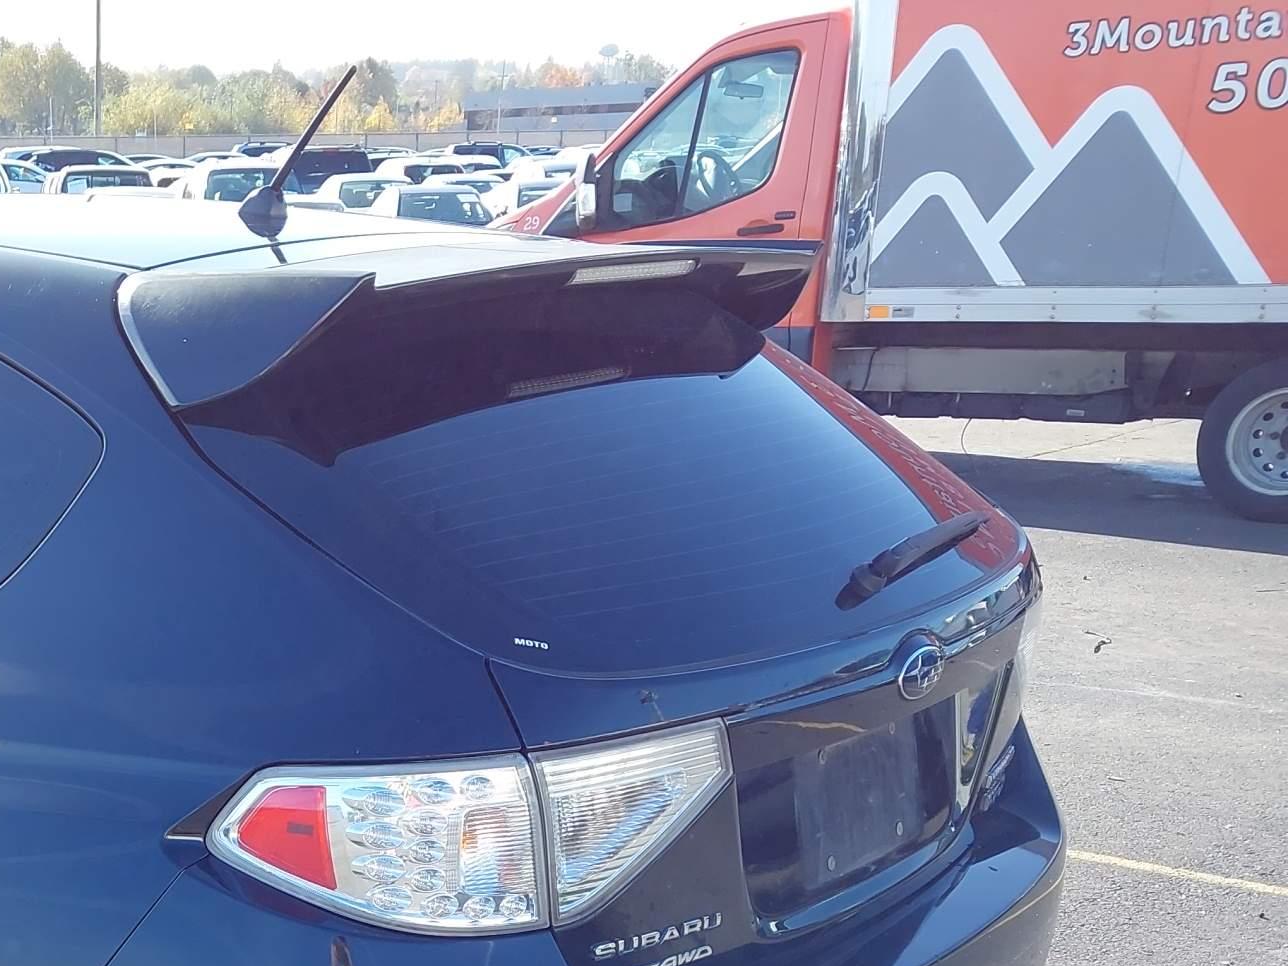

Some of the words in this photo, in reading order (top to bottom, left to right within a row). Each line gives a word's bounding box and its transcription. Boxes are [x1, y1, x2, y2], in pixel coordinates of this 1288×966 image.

[1063, 6, 1288, 58] 3Mounta
[1207, 57, 1288, 114] 50
[523, 215, 540, 230] 29
[514, 637, 549, 650] MOTO
[593, 912, 722, 961] SUBARU
